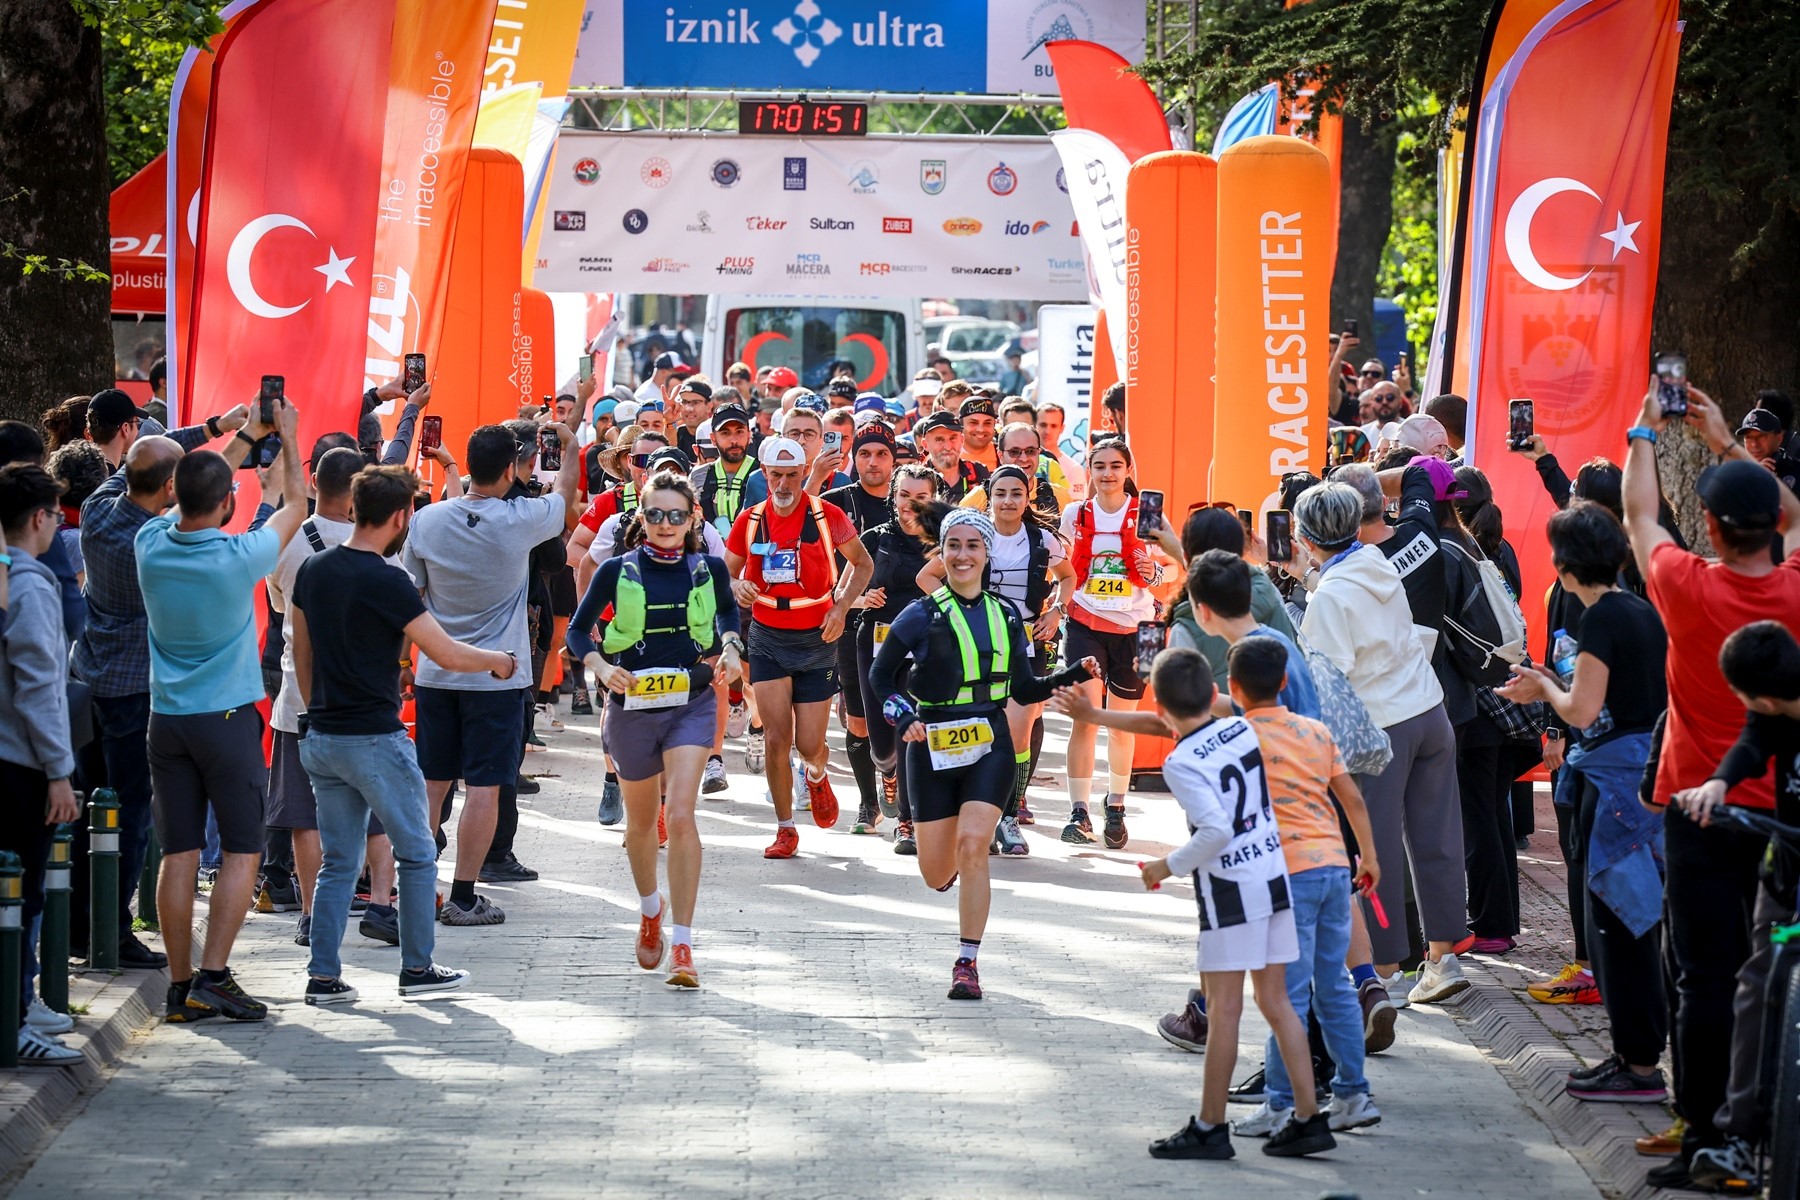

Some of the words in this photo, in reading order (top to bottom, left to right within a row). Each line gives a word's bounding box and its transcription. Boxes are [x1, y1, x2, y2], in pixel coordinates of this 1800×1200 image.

[665, 8, 761, 44] iznik
[851, 11, 945, 48] ultra
[755, 104, 861, 133] 17:01:51
[381, 177, 407, 222] the
[809, 217, 855, 231] Sultan
[1004, 220, 1030, 237] ido
[723, 256, 755, 267] PLUS
[785, 263, 831, 275] MACERA
[951, 265, 1013, 275] SheRACES
[508, 291, 521, 388] Access
[1259, 210, 1308, 477] RACESETTER
[1098, 579, 1124, 594] 214
[645, 675, 677, 692] 217
[948, 726, 979, 745] 201
[1219, 747, 1271, 838] 27
[1220, 843, 1263, 870] RAFA
